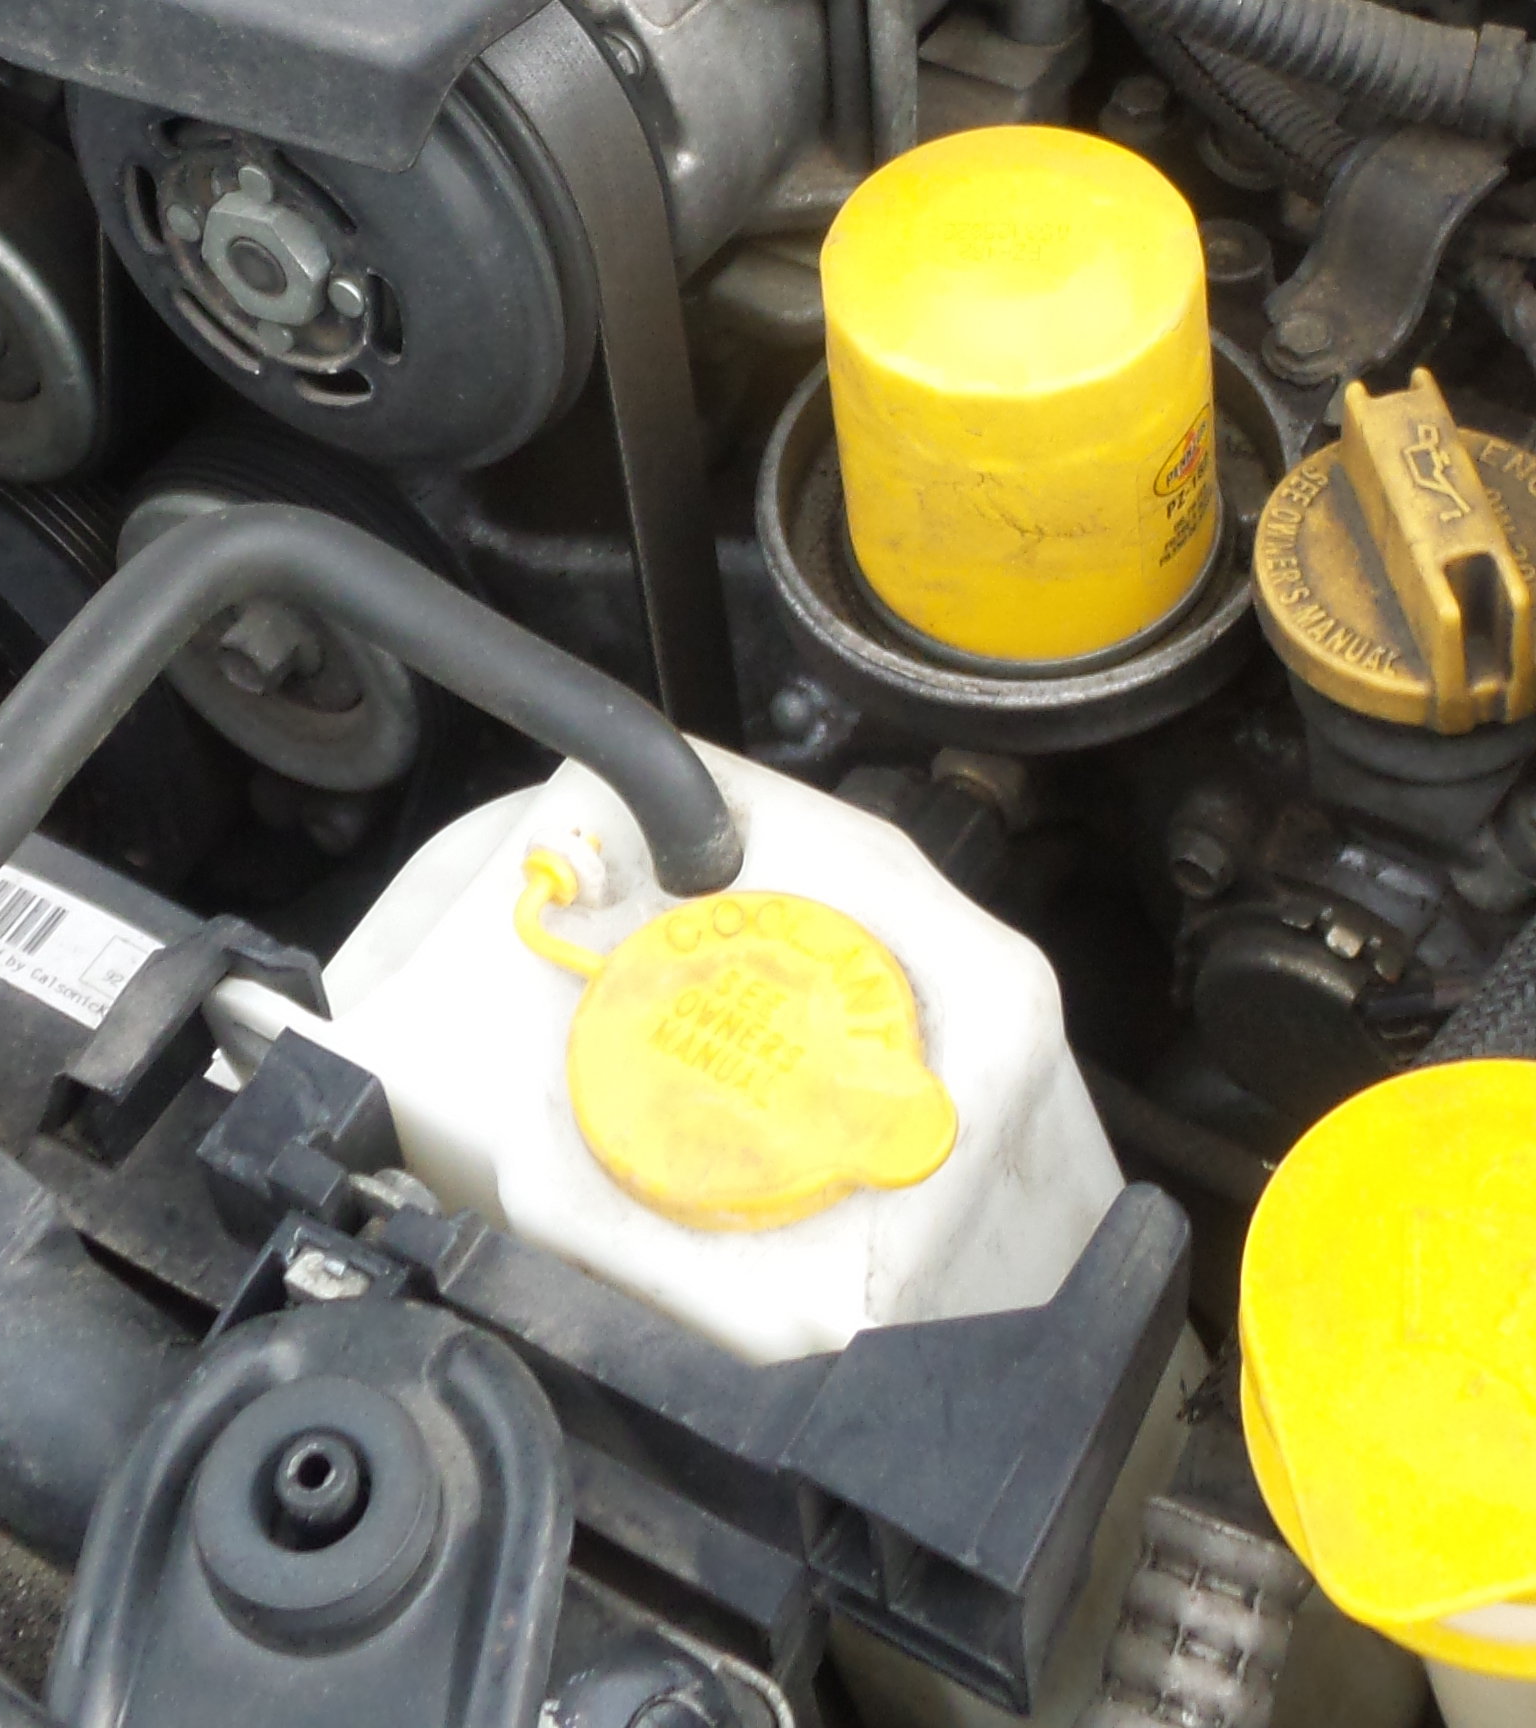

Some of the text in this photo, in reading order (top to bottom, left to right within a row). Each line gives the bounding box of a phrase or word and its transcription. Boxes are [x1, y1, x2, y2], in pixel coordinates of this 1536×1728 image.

[1264, 463, 1402, 675] SEE OWNER'S MANUAL
[4, 953, 26, 975] by
[667, 900, 897, 1047] COOLANT
[719, 969, 789, 1018] SEE
[648, 1025, 780, 1110] MANUAL
[674, 988, 805, 1074] OWNERS
